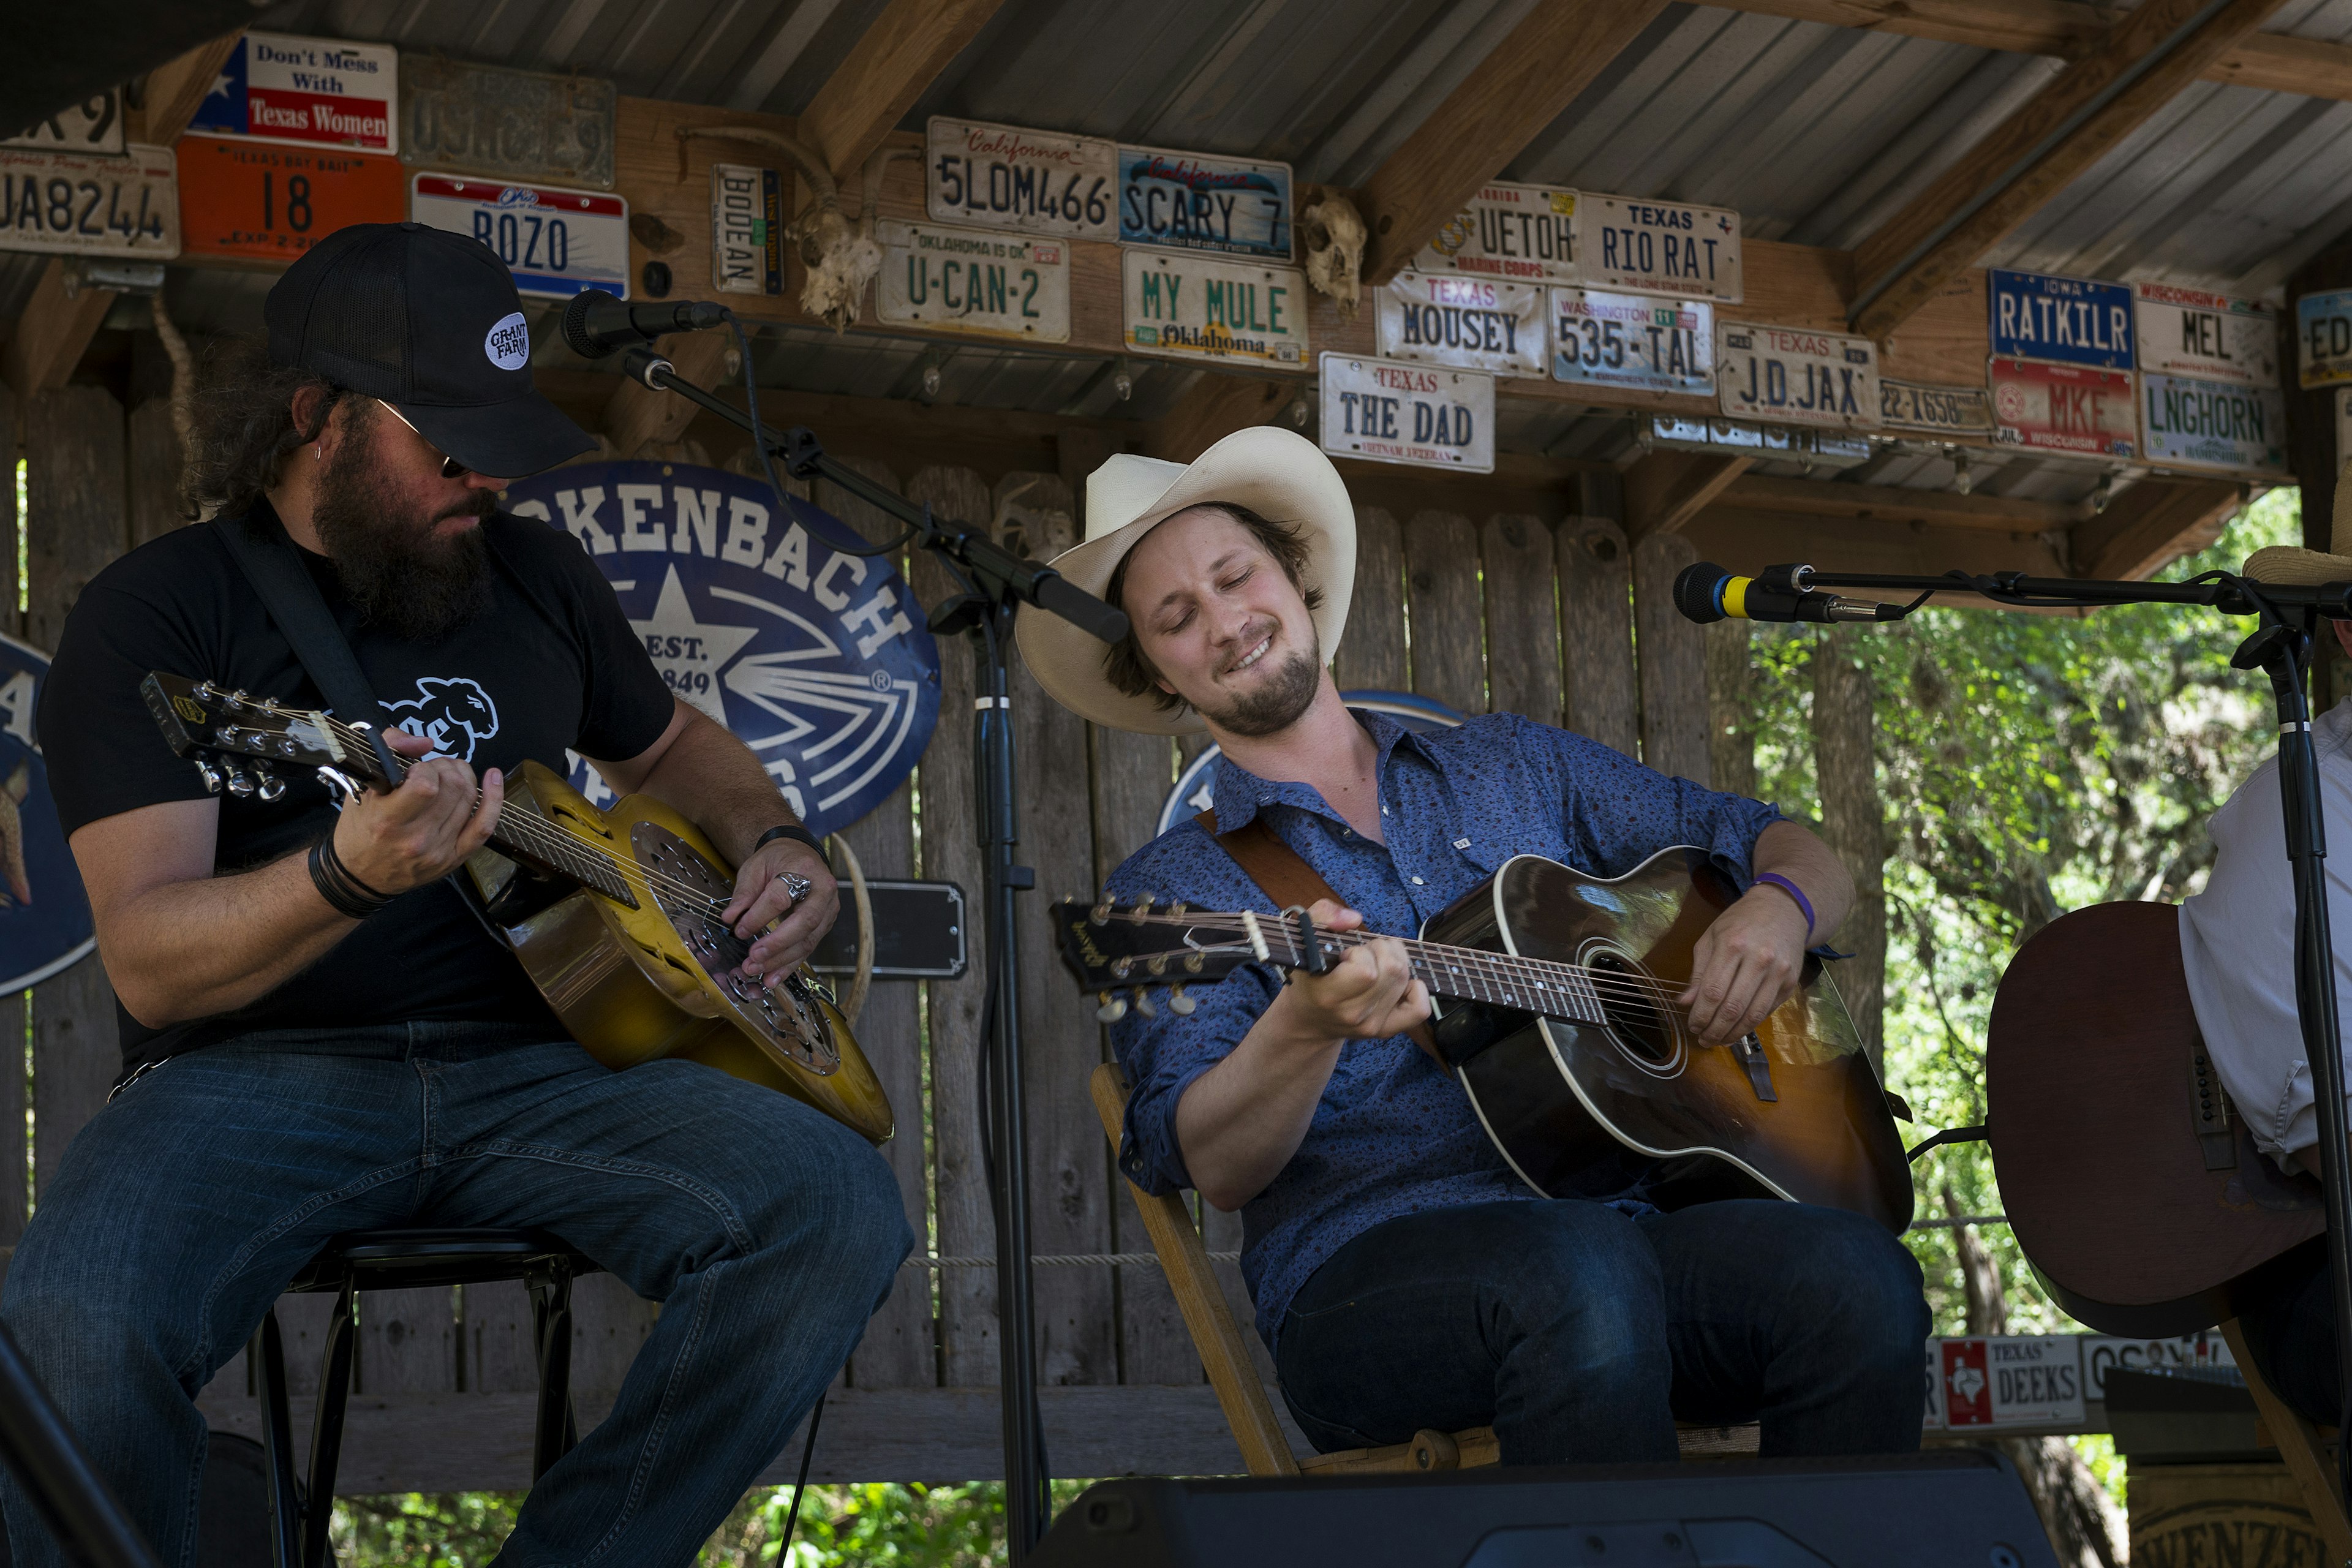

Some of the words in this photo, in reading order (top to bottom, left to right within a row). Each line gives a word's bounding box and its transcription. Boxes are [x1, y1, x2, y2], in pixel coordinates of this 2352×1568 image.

[257, 45, 315, 66] Don't
[324, 52, 379, 74] Mess
[293, 72, 343, 93] With
[249, 97, 309, 130] Texas
[312, 103, 387, 137] Women
[968, 129, 1082, 165] California
[1148, 156, 1260, 189] California
[263, 170, 312, 233] 18
[499, 187, 538, 205] Ohio
[941, 154, 1106, 225] 5LOM466
[724, 178, 754, 279] BODEAN
[1123, 185, 1235, 243] SCARY
[1262, 198, 1281, 246] 7
[1628, 205, 1693, 230] TEXAS
[232, 230, 268, 245] EXP
[473, 210, 567, 271] BOZO
[919, 235, 990, 256] OKLAHOMA
[993, 243, 1005, 257] IS
[1010, 246, 1025, 260] OK
[1457, 256, 1501, 274] MARINE
[1504, 260, 1544, 278] CORPS
[1603, 227, 1653, 273] RIO
[1664, 234, 1717, 281] RAT
[1427, 279, 1495, 306] TEXAS
[2044, 279, 2082, 296] IOWA
[2139, 282, 2214, 306] WISCONSIN
[1143, 271, 1181, 321] MY
[1206, 279, 1287, 334] MULE
[1561, 301, 1650, 322] WASHINGTON
[491, 323, 526, 347] GRANT
[1403, 303, 1518, 354] MOUSEY
[1999, 292, 2127, 353] RATKILR
[2182, 310, 2232, 361] MEL
[497, 337, 526, 359] FARM
[1164, 323, 1265, 353] Oklahoma
[1768, 331, 1829, 356] TEXAS
[1376, 367, 1438, 393] TEXAS
[1340, 391, 1400, 439] THE
[1412, 401, 1473, 446] DAD
[2148, 386, 2264, 443] LNGHORN
[1362, 442, 1403, 457] VIETNAM
[1407, 447, 1452, 462] VETERAN
[2030, 431, 2098, 451] WISCONSIN
[646, 636, 707, 660] EST.
[663, 669, 710, 694] 849
[1992, 1341, 2044, 1362] TEXAS
[1998, 1364, 2077, 1405] DEEKS
